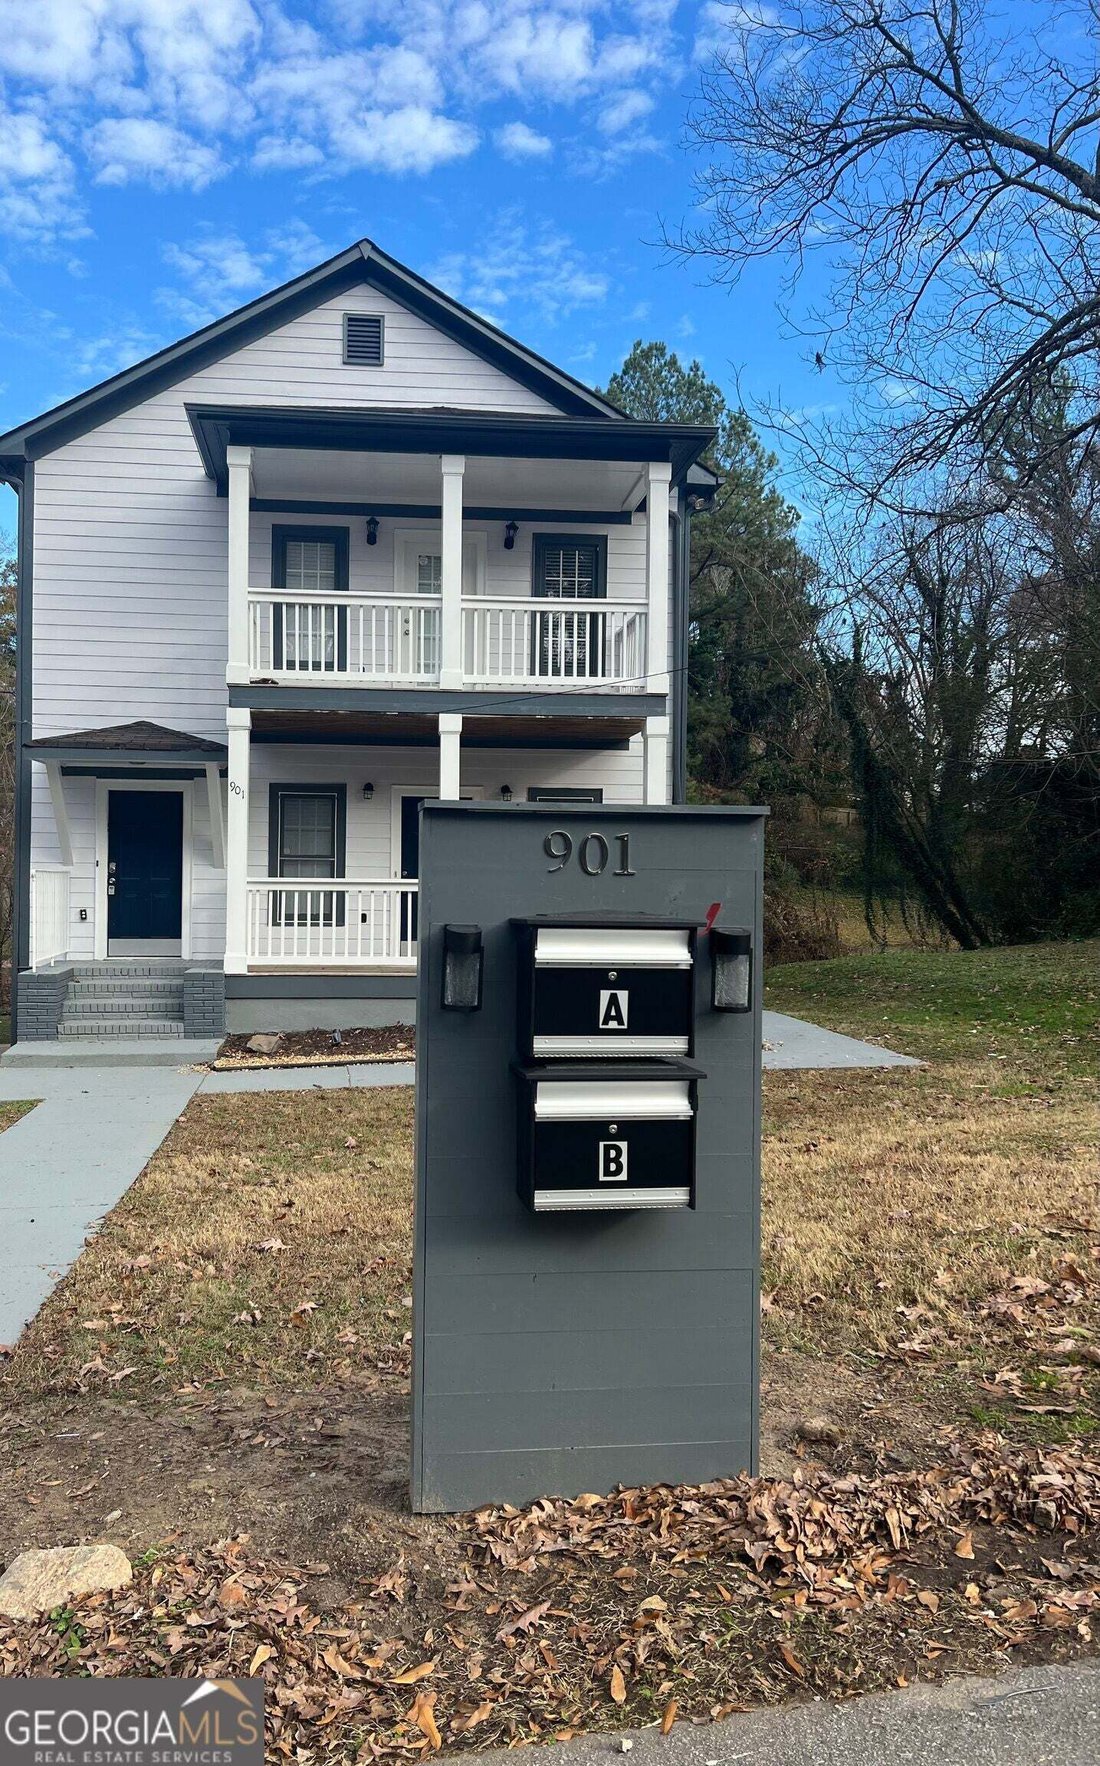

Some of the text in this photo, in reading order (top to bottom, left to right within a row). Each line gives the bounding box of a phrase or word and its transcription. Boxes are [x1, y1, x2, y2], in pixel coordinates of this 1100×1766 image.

[230, 782, 244, 799] 901
[543, 830, 637, 876] 901
[601, 992, 625, 1027] A
[602, 1143, 624, 1178] B
